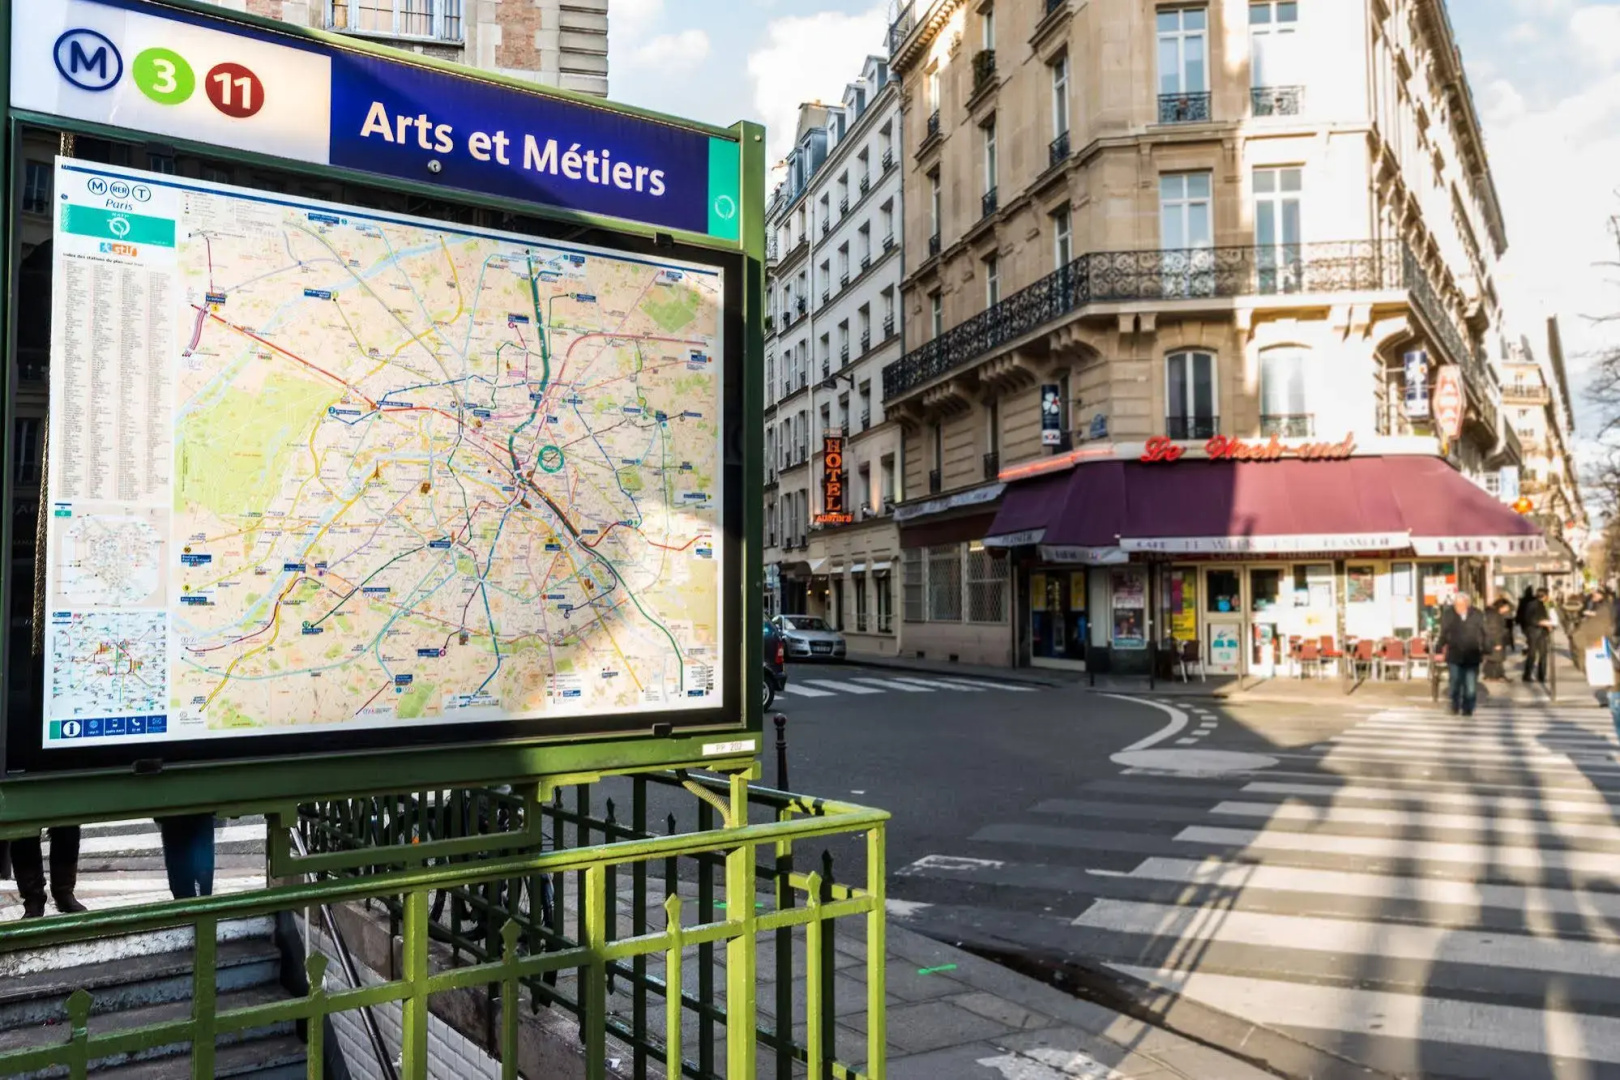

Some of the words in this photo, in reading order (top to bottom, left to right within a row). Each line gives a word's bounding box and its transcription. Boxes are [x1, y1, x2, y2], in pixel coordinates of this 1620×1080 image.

[152, 59, 177, 94] 3
[213, 72, 252, 110] 11
[360, 101, 454, 153] Arts
[468, 130, 510, 165] et
[523, 134, 666, 196] Métiers
[105, 199, 133, 211] Paris
[1141, 435, 1186, 463] Le
[825, 439, 842, 511] HOTEL
